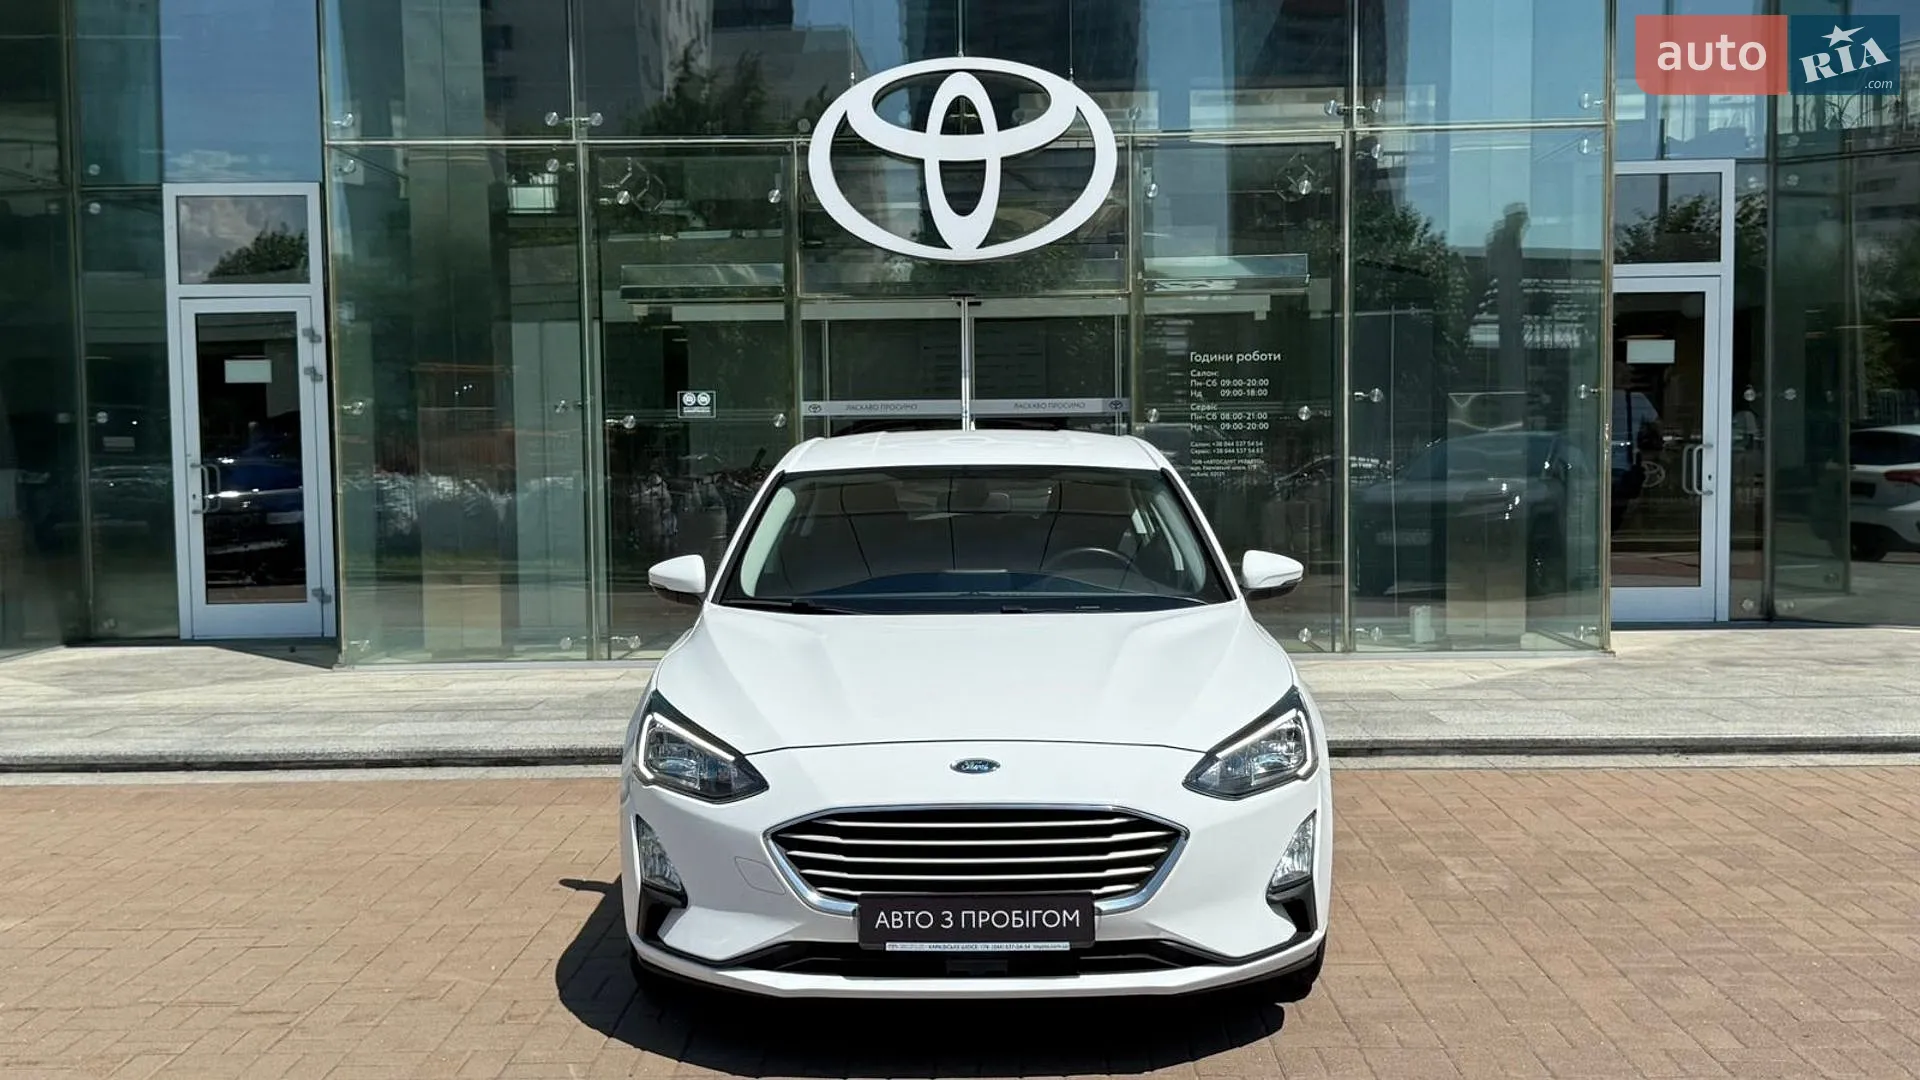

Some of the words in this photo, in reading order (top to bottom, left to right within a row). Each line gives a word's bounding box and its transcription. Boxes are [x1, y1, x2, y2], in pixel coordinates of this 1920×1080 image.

[1190, 351, 1233, 363] Години
[1236, 350, 1281, 364] роботи
[1190, 379, 1218, 387] Пн-Сб
[1220, 378, 1270, 387] 09:00-20:00
[1190, 389, 1203, 398] Нд
[1220, 388, 1269, 397] 09:00-18:00
[1190, 423, 1203, 432] Нд
[1220, 422, 1270, 431] 09:00-20:00
[874, 911, 934, 929] АВТО
[940, 911, 954, 929] З
[961, 909, 1080, 929] ПРОБІГОМ
